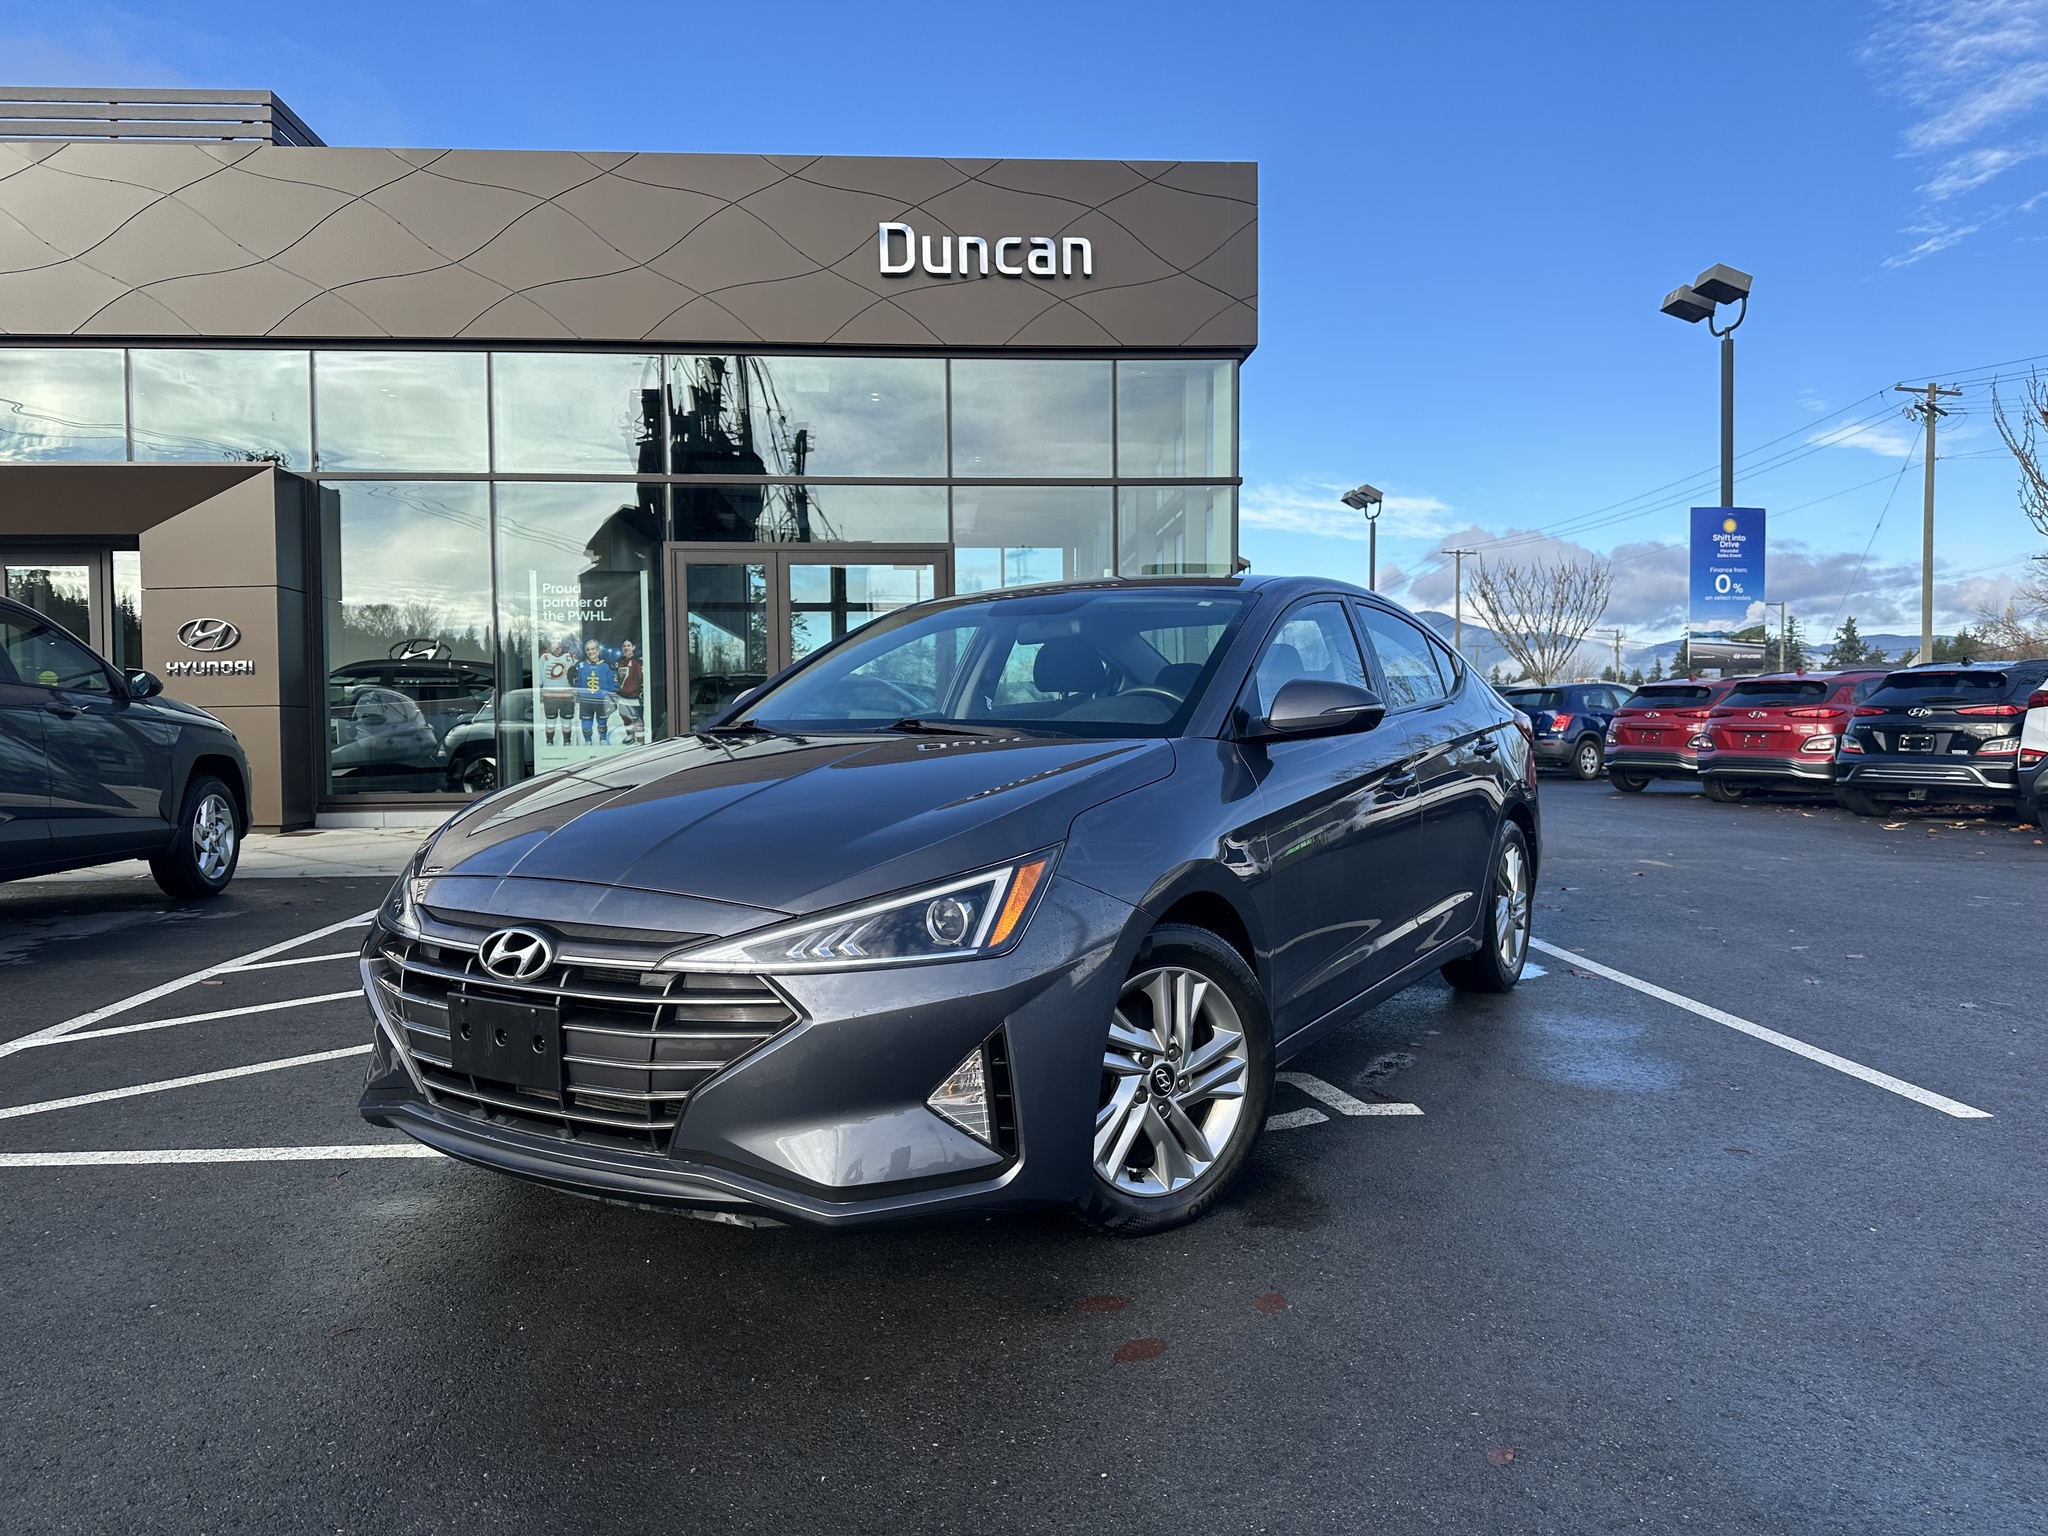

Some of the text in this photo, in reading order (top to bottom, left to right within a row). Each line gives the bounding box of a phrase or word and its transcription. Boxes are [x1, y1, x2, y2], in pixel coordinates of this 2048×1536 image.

[878, 221, 1093, 276] Duncan
[1712, 533, 1747, 542] Shift into
[542, 583, 582, 594] Proud
[542, 596, 608, 609] partner of
[542, 610, 612, 622] the PWHL.
[165, 660, 254, 675] HYUNDAI
